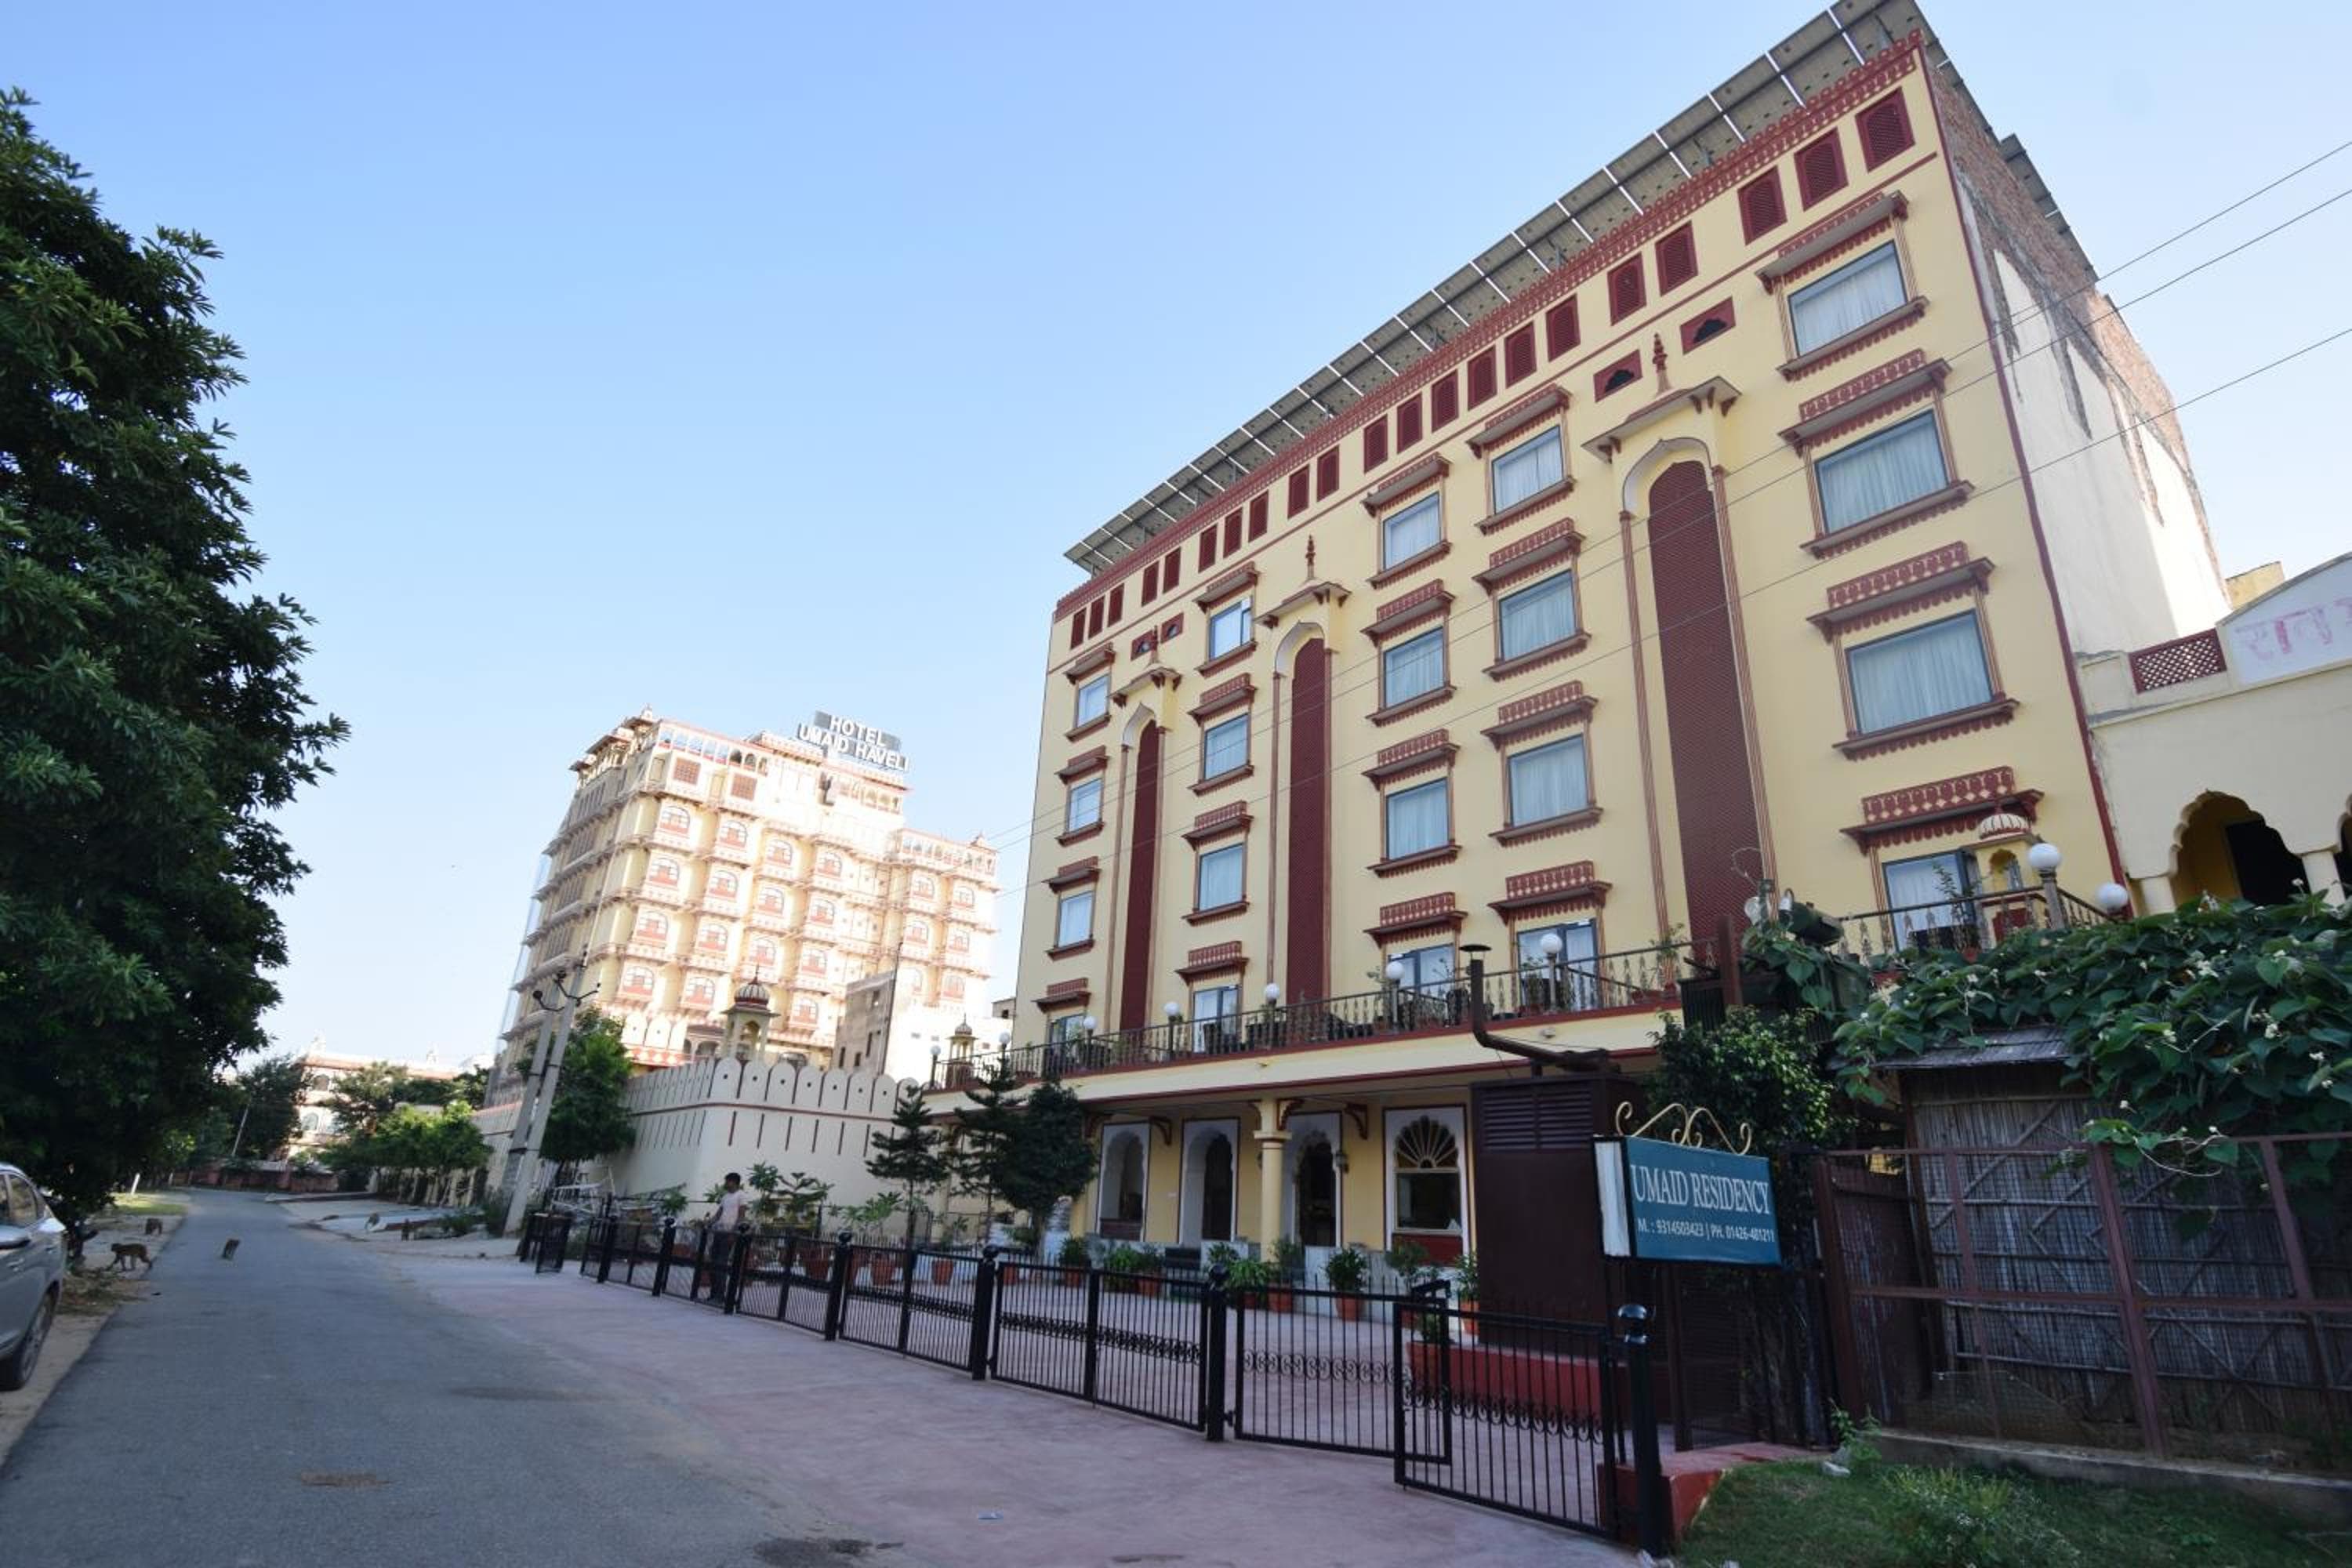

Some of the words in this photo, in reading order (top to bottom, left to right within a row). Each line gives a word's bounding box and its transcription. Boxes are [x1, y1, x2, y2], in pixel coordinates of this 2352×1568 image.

[798, 723, 849, 753] UMAID
[855, 743, 910, 771] HAVELI
[829, 715, 886, 746] HOTEL
[1630, 1164, 1690, 1206] UMAID
[1690, 1173, 1770, 1214] RESIDENCY
